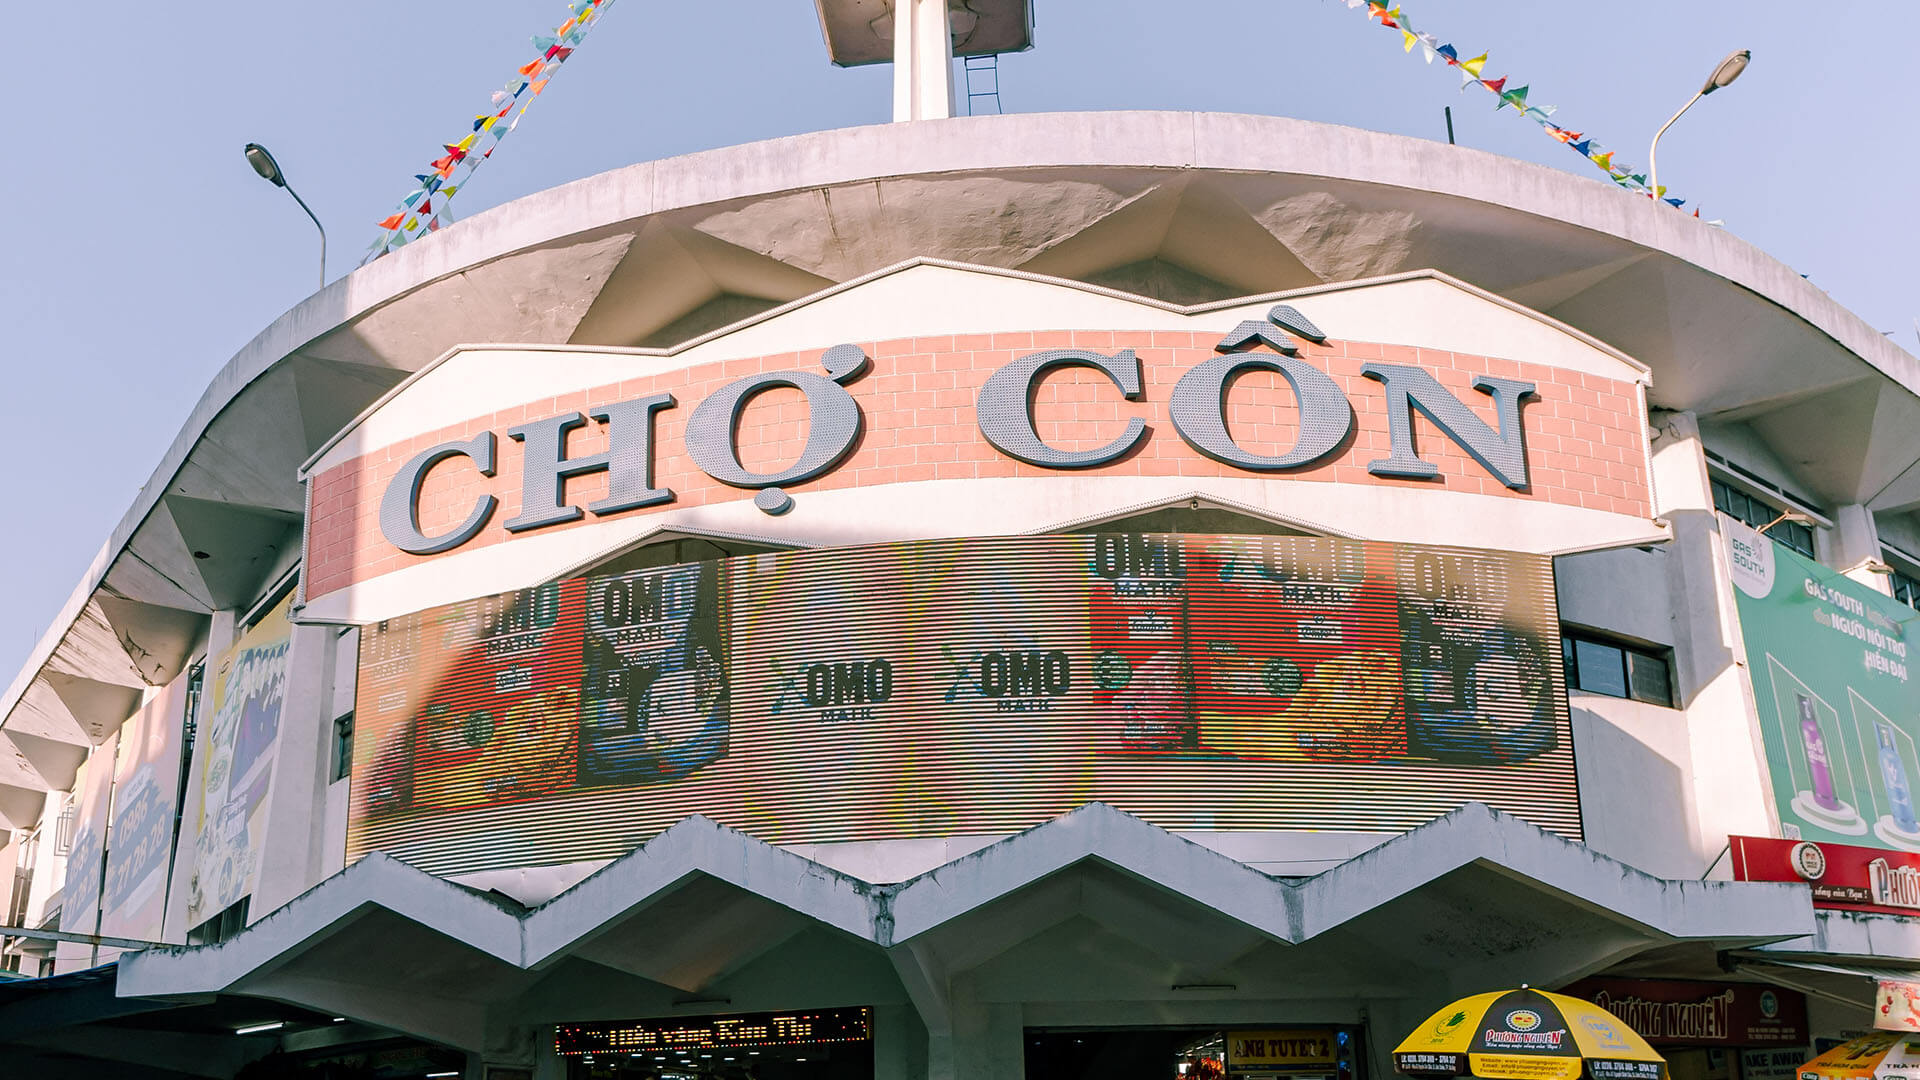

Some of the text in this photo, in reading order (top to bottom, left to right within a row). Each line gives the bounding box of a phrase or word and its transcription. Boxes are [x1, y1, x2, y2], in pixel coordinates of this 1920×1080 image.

[379, 305, 1536, 555] CHỢ CỒN
[1732, 539, 1752, 557] GAS
[1733, 553, 1766, 578] SOUTH
[604, 570, 694, 626] OMO
[1804, 578, 1864, 617] GAS SOUTH
[807, 658, 893, 707] OMO
[981, 650, 1070, 698] OMO
[1869, 858, 1920, 909] PHƯƠ
